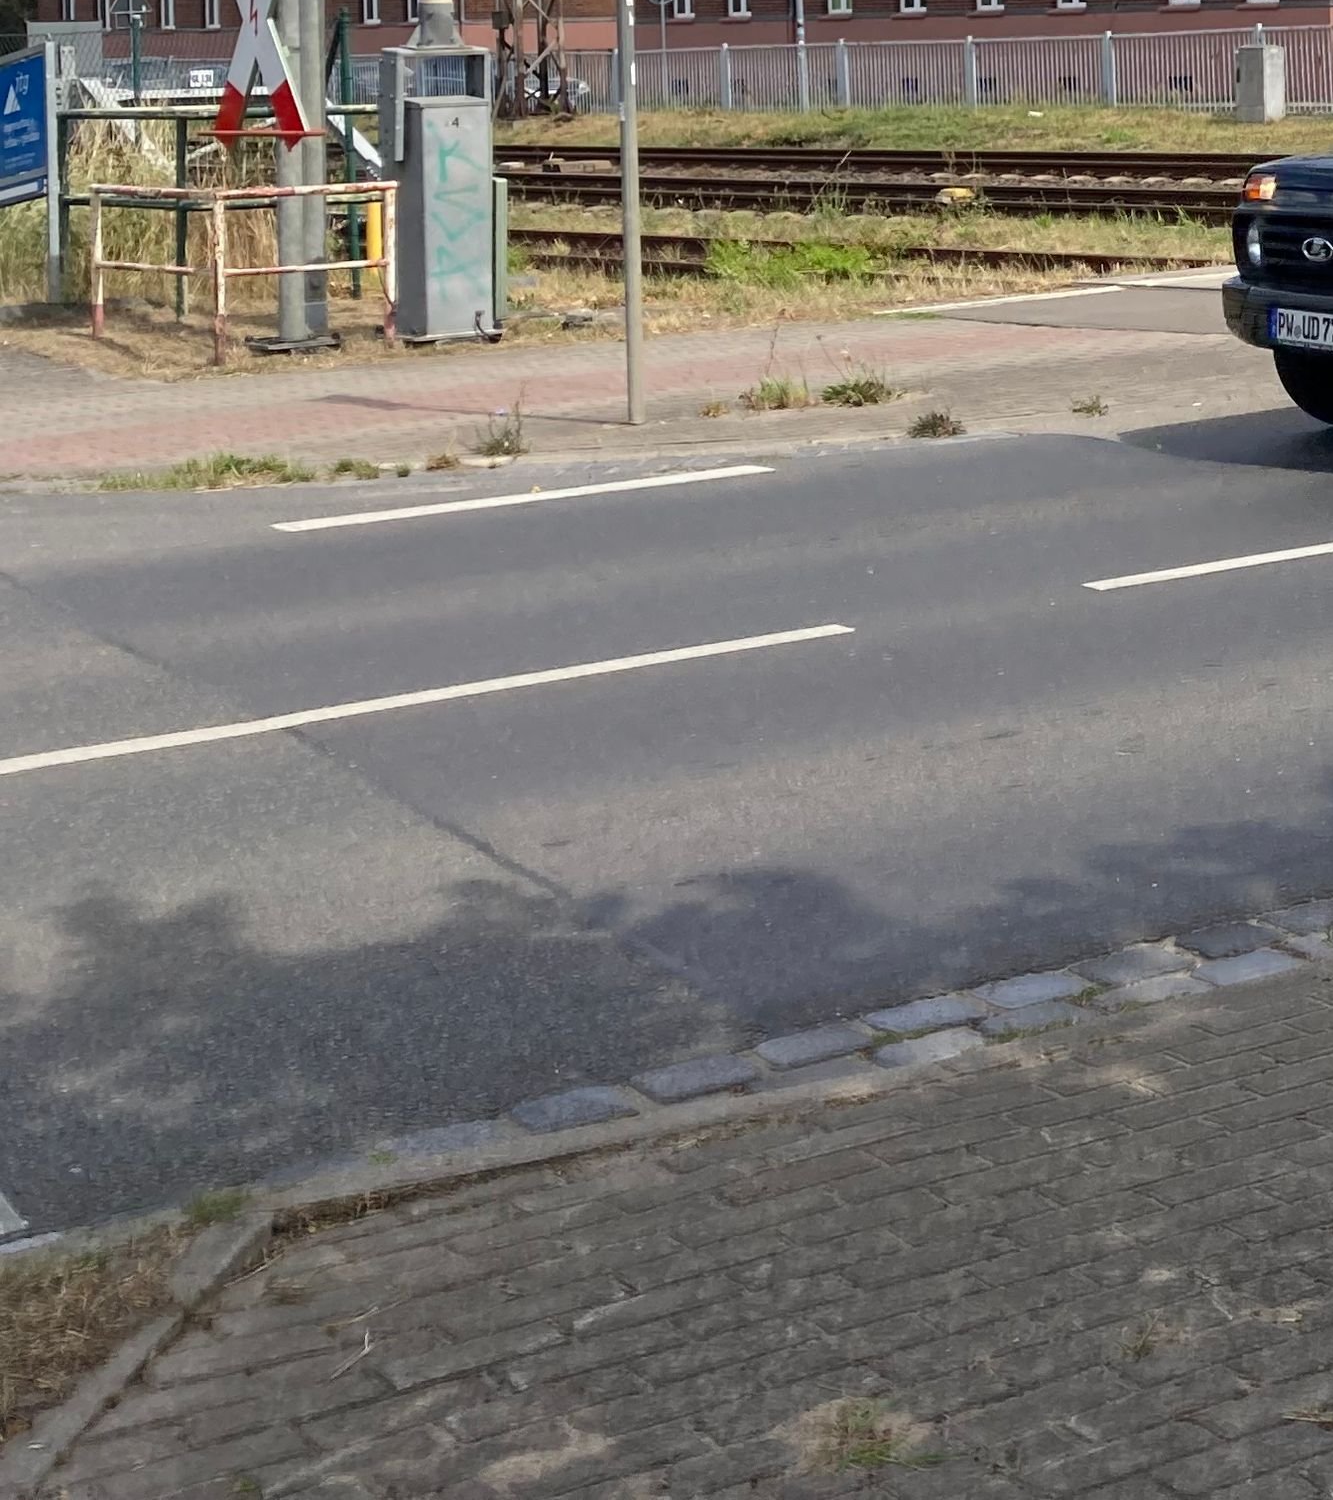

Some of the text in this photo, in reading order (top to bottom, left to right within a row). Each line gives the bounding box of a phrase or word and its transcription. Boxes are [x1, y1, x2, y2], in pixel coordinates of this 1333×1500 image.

[451, 116, 460, 128] 4
[1278, 312, 1294, 337] PW
[1302, 315, 1320, 340] UD
